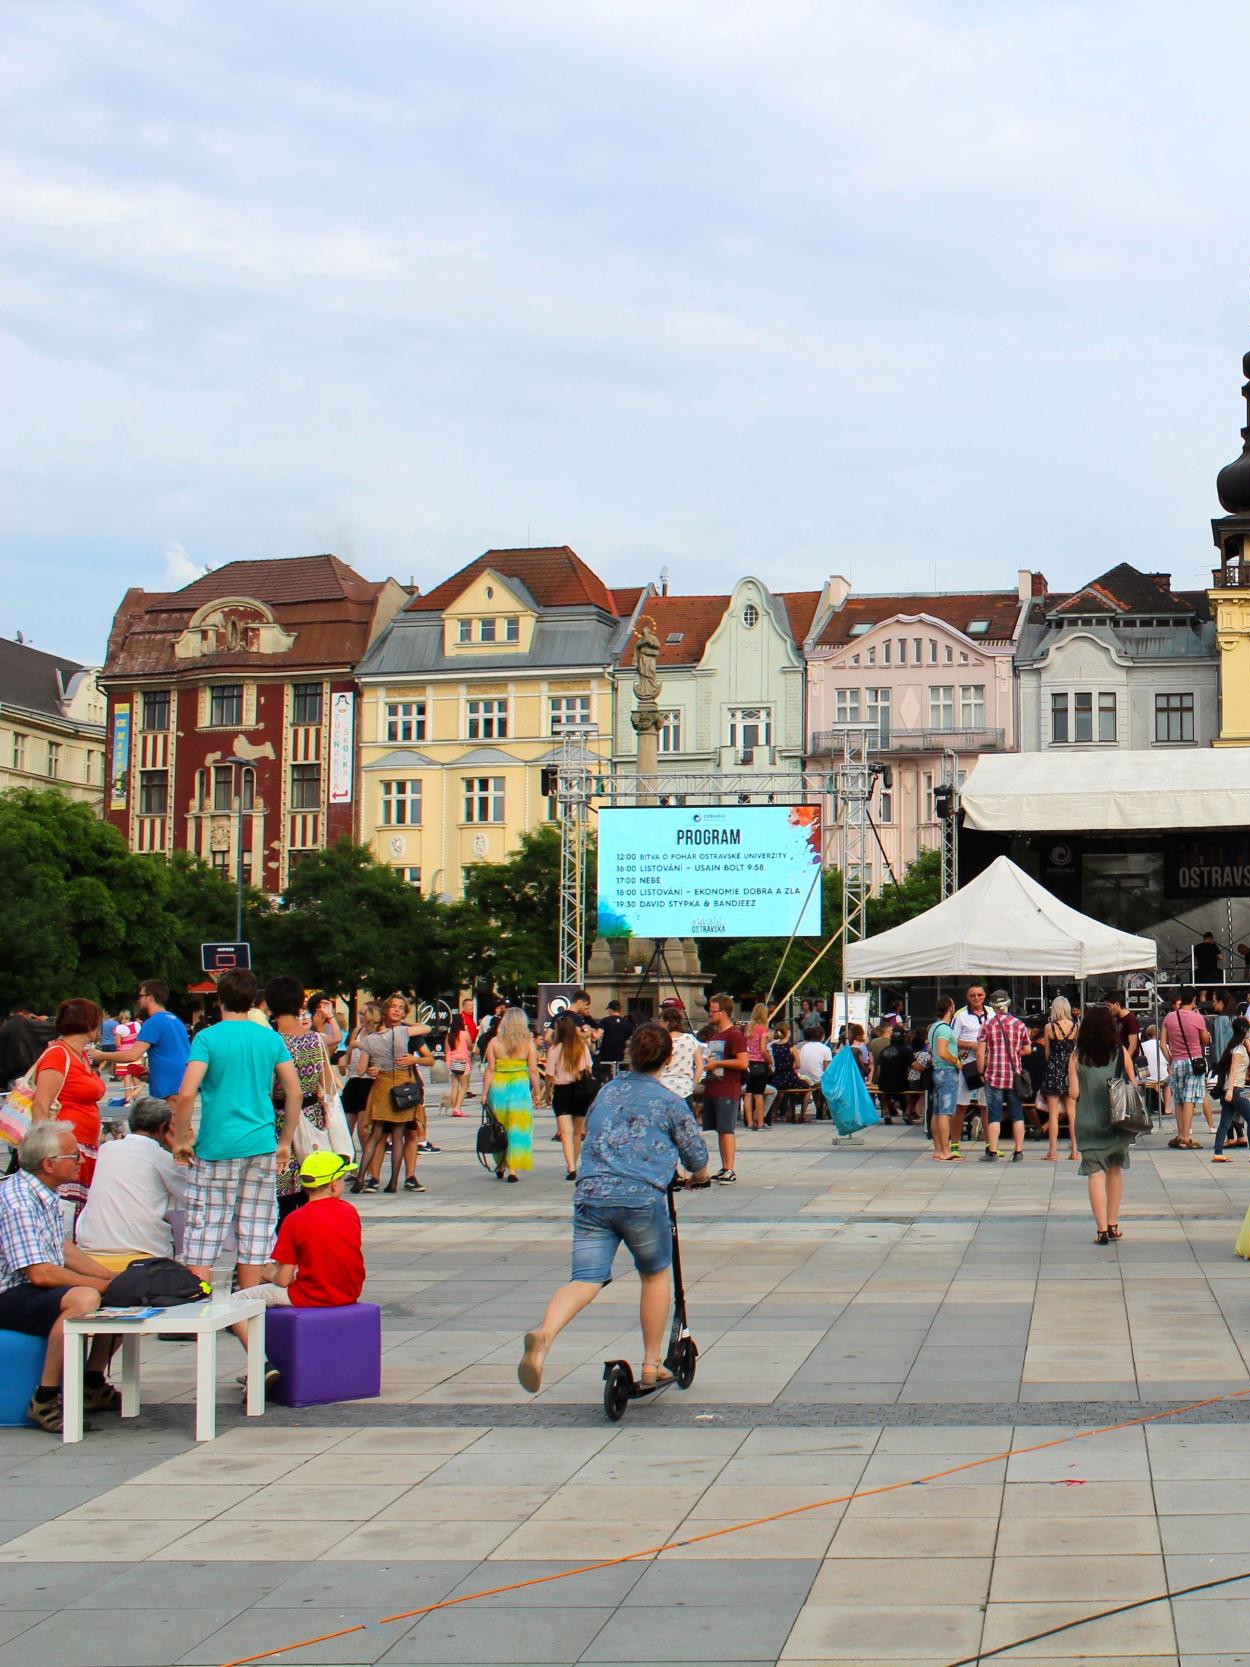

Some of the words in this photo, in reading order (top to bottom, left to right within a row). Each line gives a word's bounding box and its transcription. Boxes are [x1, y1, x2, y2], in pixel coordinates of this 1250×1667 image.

[677, 828, 741, 845] PROGRAM
[617, 853, 637, 861] 12:00
[640, 853, 660, 861] BITVA
[662, 853, 669, 861] O
[671, 852, 697, 861] POHÁR
[699, 852, 741, 860] OSTRAVSKÉ
[744, 852, 787, 860] UNIVERZITY
[640, 863, 683, 872] LISTOVÁNÍ
[694, 864, 721, 872] USAIN
[724, 864, 745, 872] BOLT
[640, 876, 661, 884] NEBE
[640, 887, 683, 896] LISTOVÁNÍ
[694, 888, 740, 896] EKONOMIE
[785, 887, 801, 895] ZLA
[640, 900, 666, 908] DAVID
[668, 900, 701, 908] STYPKA
